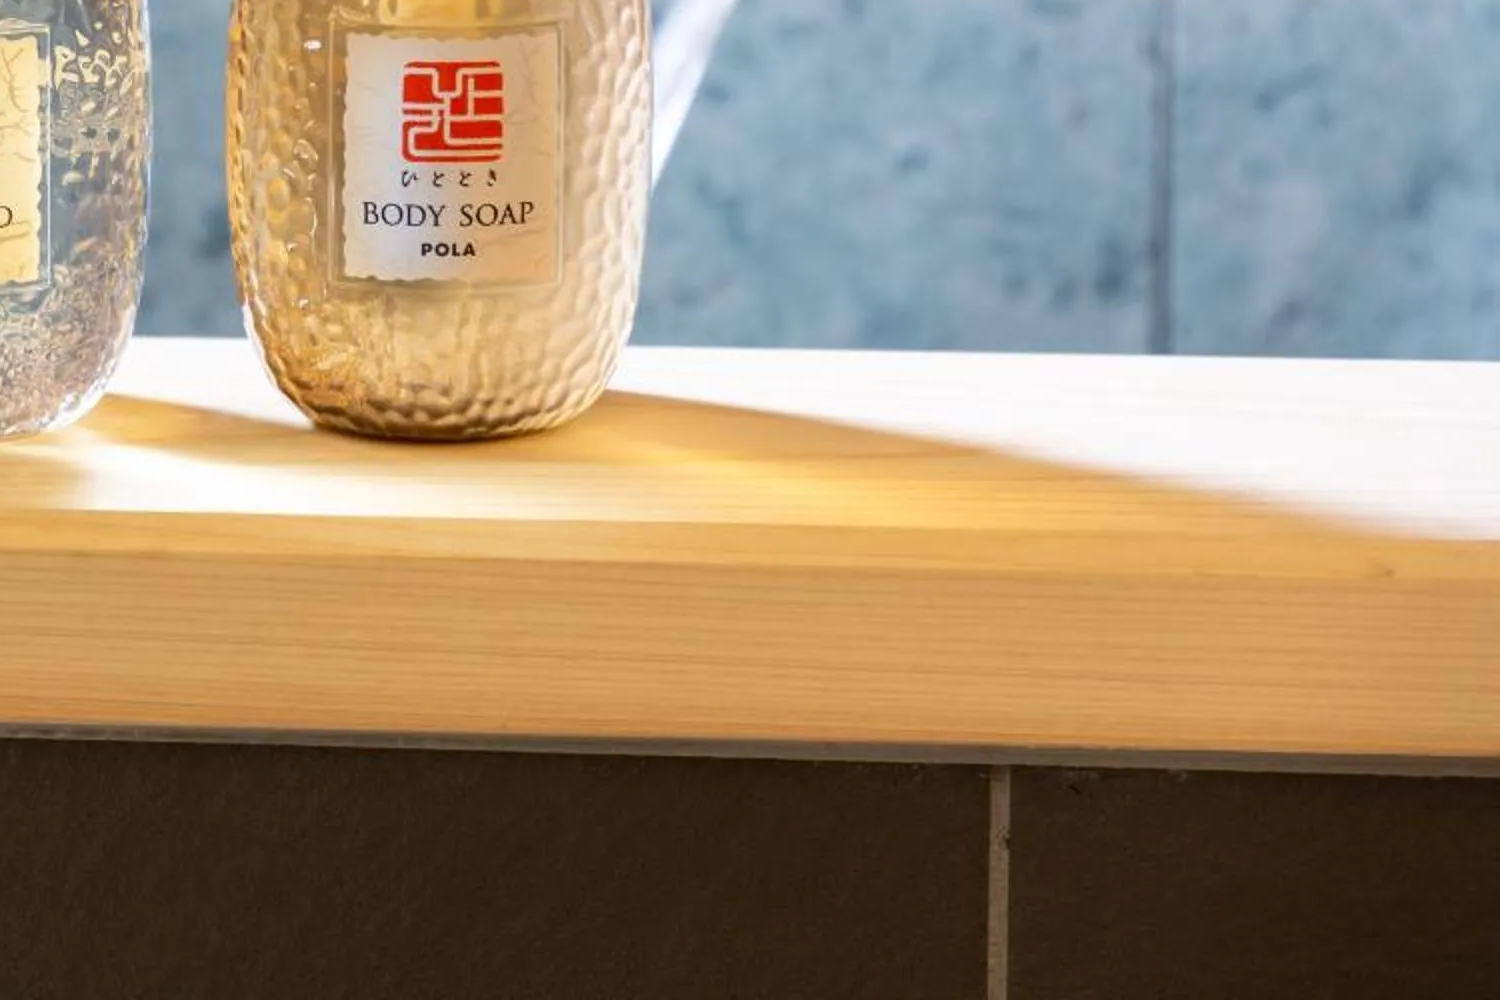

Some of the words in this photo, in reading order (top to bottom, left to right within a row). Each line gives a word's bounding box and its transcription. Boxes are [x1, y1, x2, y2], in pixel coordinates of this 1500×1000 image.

[401, 170, 497, 188] ひととき
[363, 201, 445, 227] BODY
[459, 201, 534, 227] SOAP
[420, 243, 476, 257] POLA
